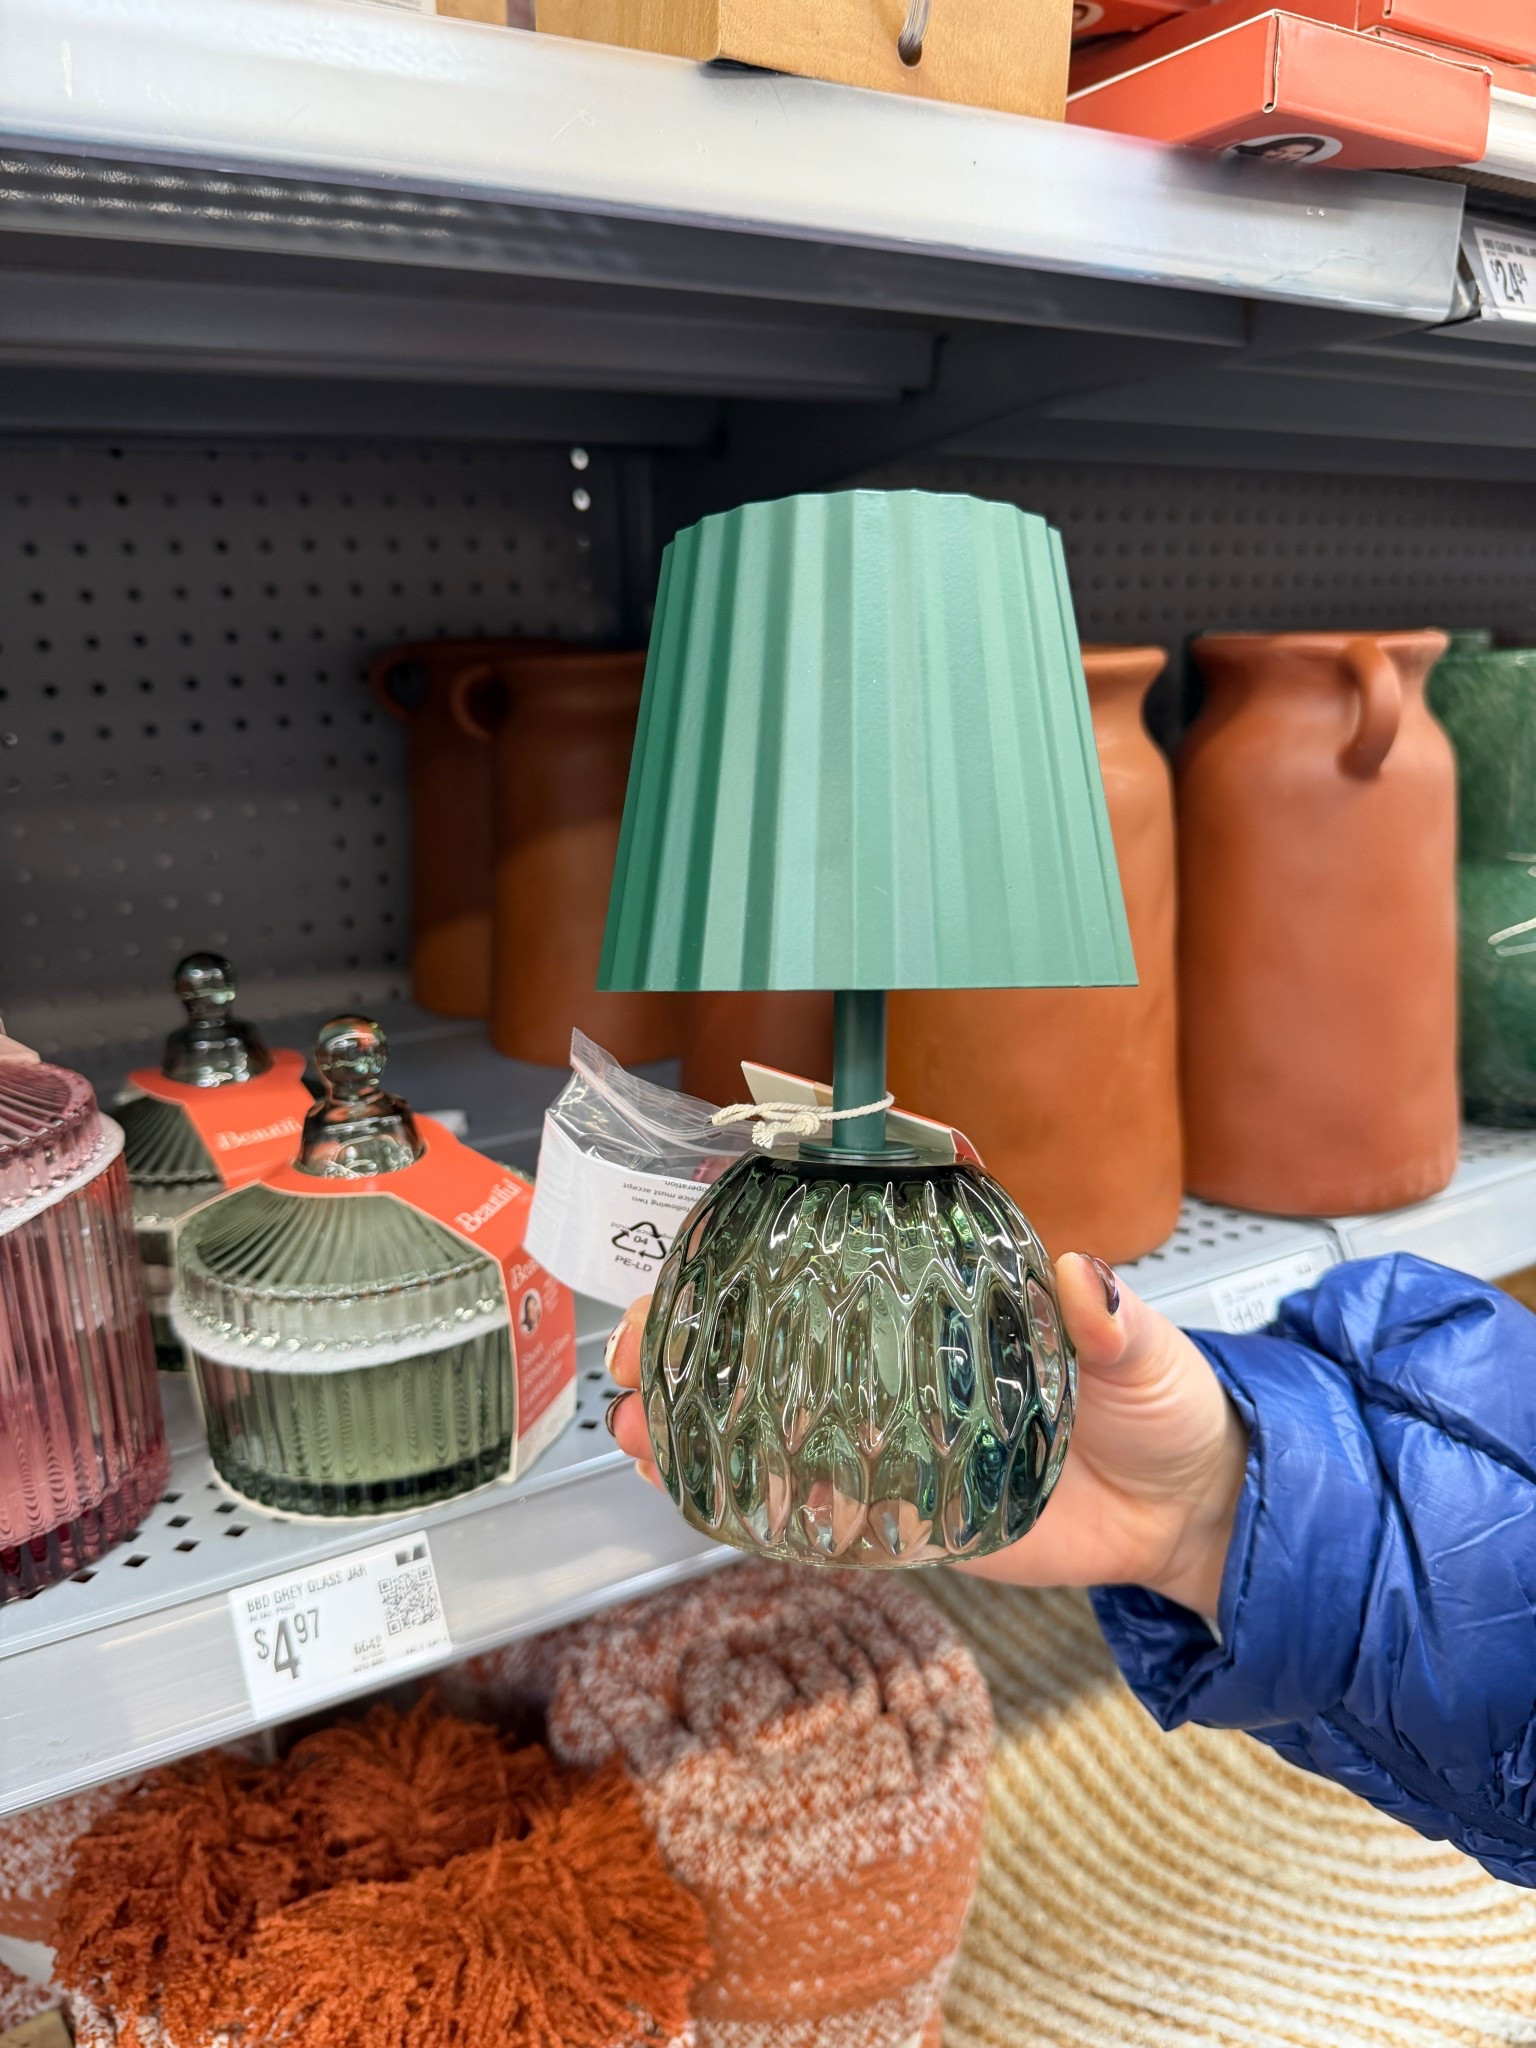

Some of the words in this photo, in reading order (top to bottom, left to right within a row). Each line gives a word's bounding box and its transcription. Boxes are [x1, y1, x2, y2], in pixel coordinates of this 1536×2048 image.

[622, 1182, 653, 1195] accept
[653, 1189, 677, 1199] must
[454, 1177, 523, 1233] Beautiful
[631, 1195, 649, 1206] two
[650, 1196, 691, 1213] following
[632, 1234, 649, 1246] 04
[614, 1254, 653, 1273] PE-LD
[247, 1593, 270, 1614] BBD
[273, 1584, 304, 1605] GREY
[307, 1571, 344, 1594] GLASS
[347, 1563, 368, 1582] JAR
